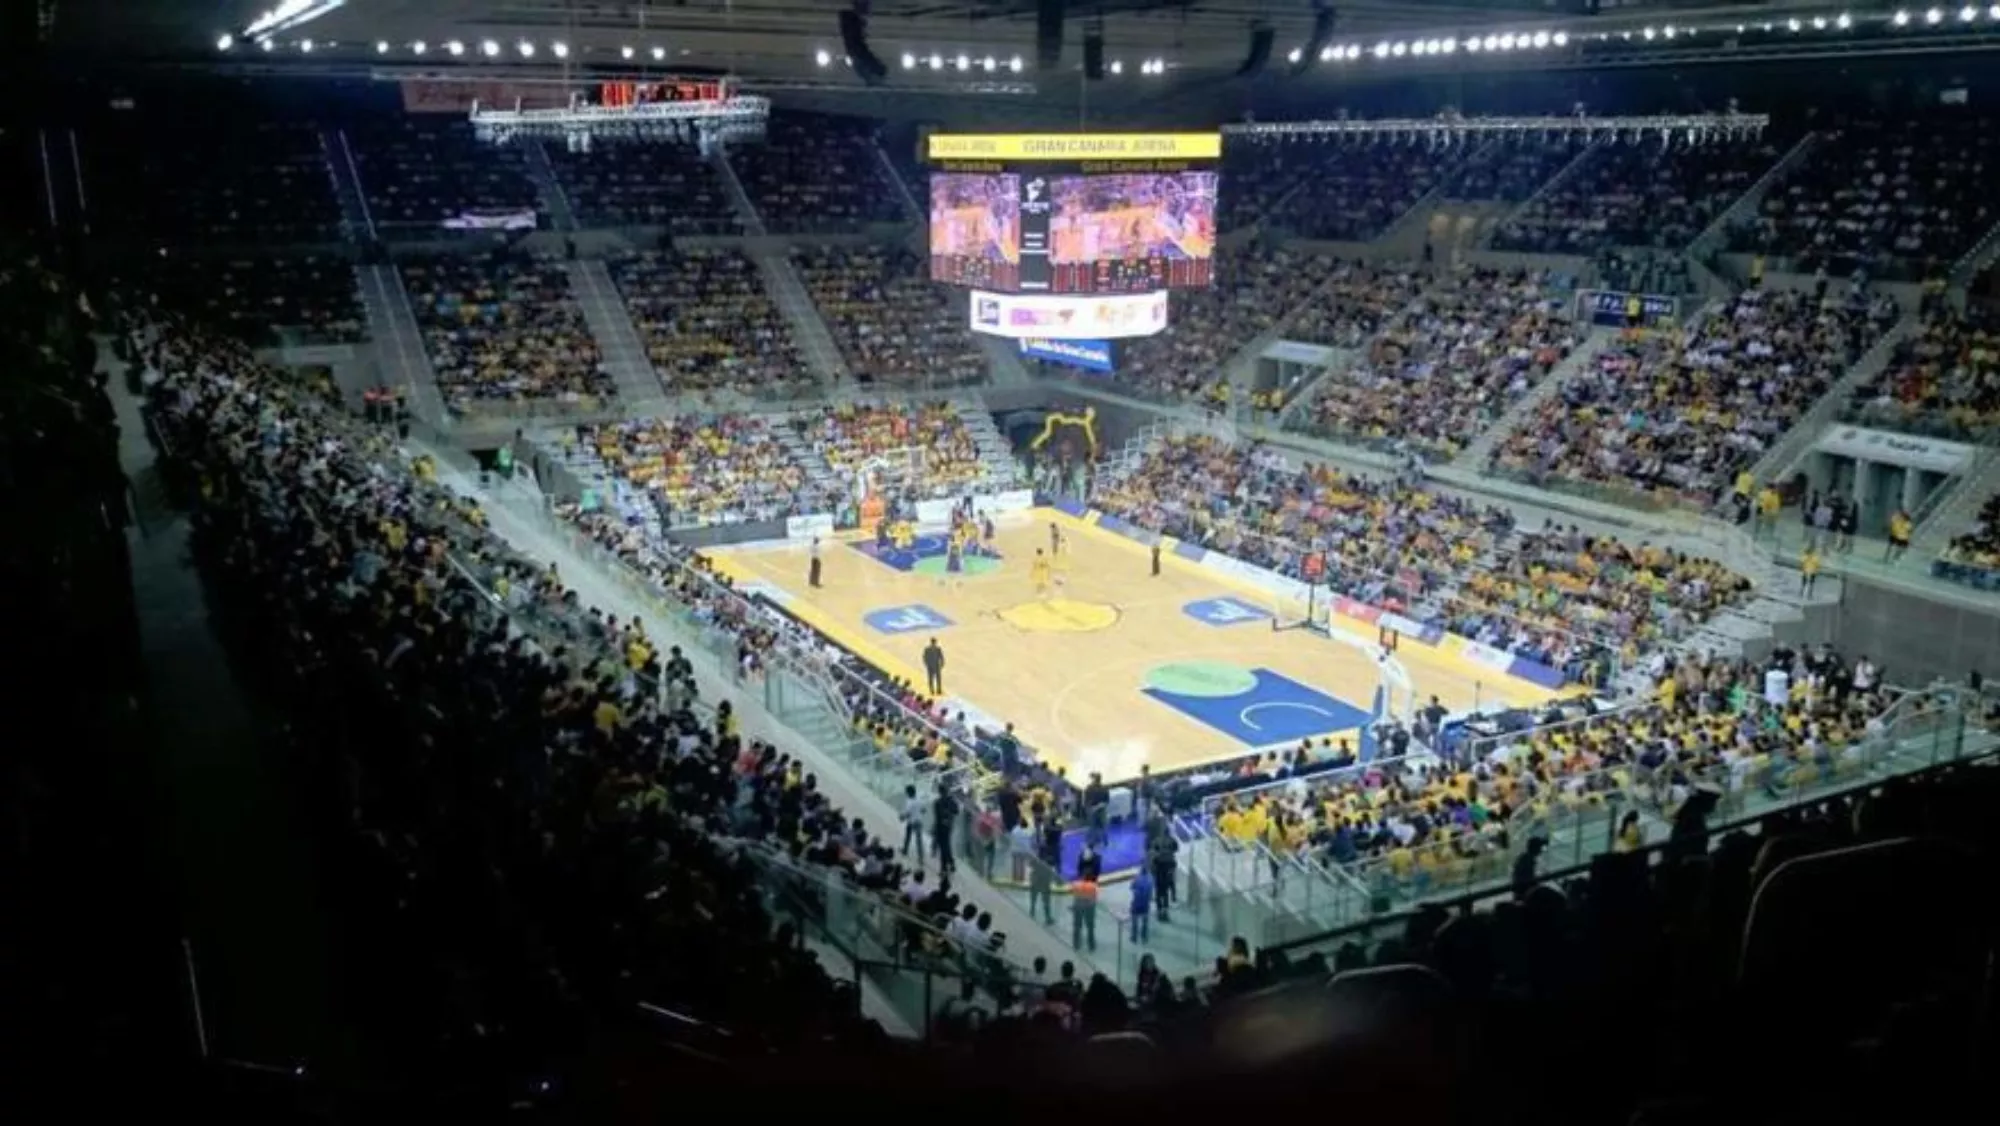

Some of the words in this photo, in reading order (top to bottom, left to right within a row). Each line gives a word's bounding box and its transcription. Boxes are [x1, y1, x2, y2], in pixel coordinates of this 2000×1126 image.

[1023, 138, 1066, 153] GRAN
[1068, 138, 1127, 153] CANARIA
[1132, 138, 1177, 153] ARENA
